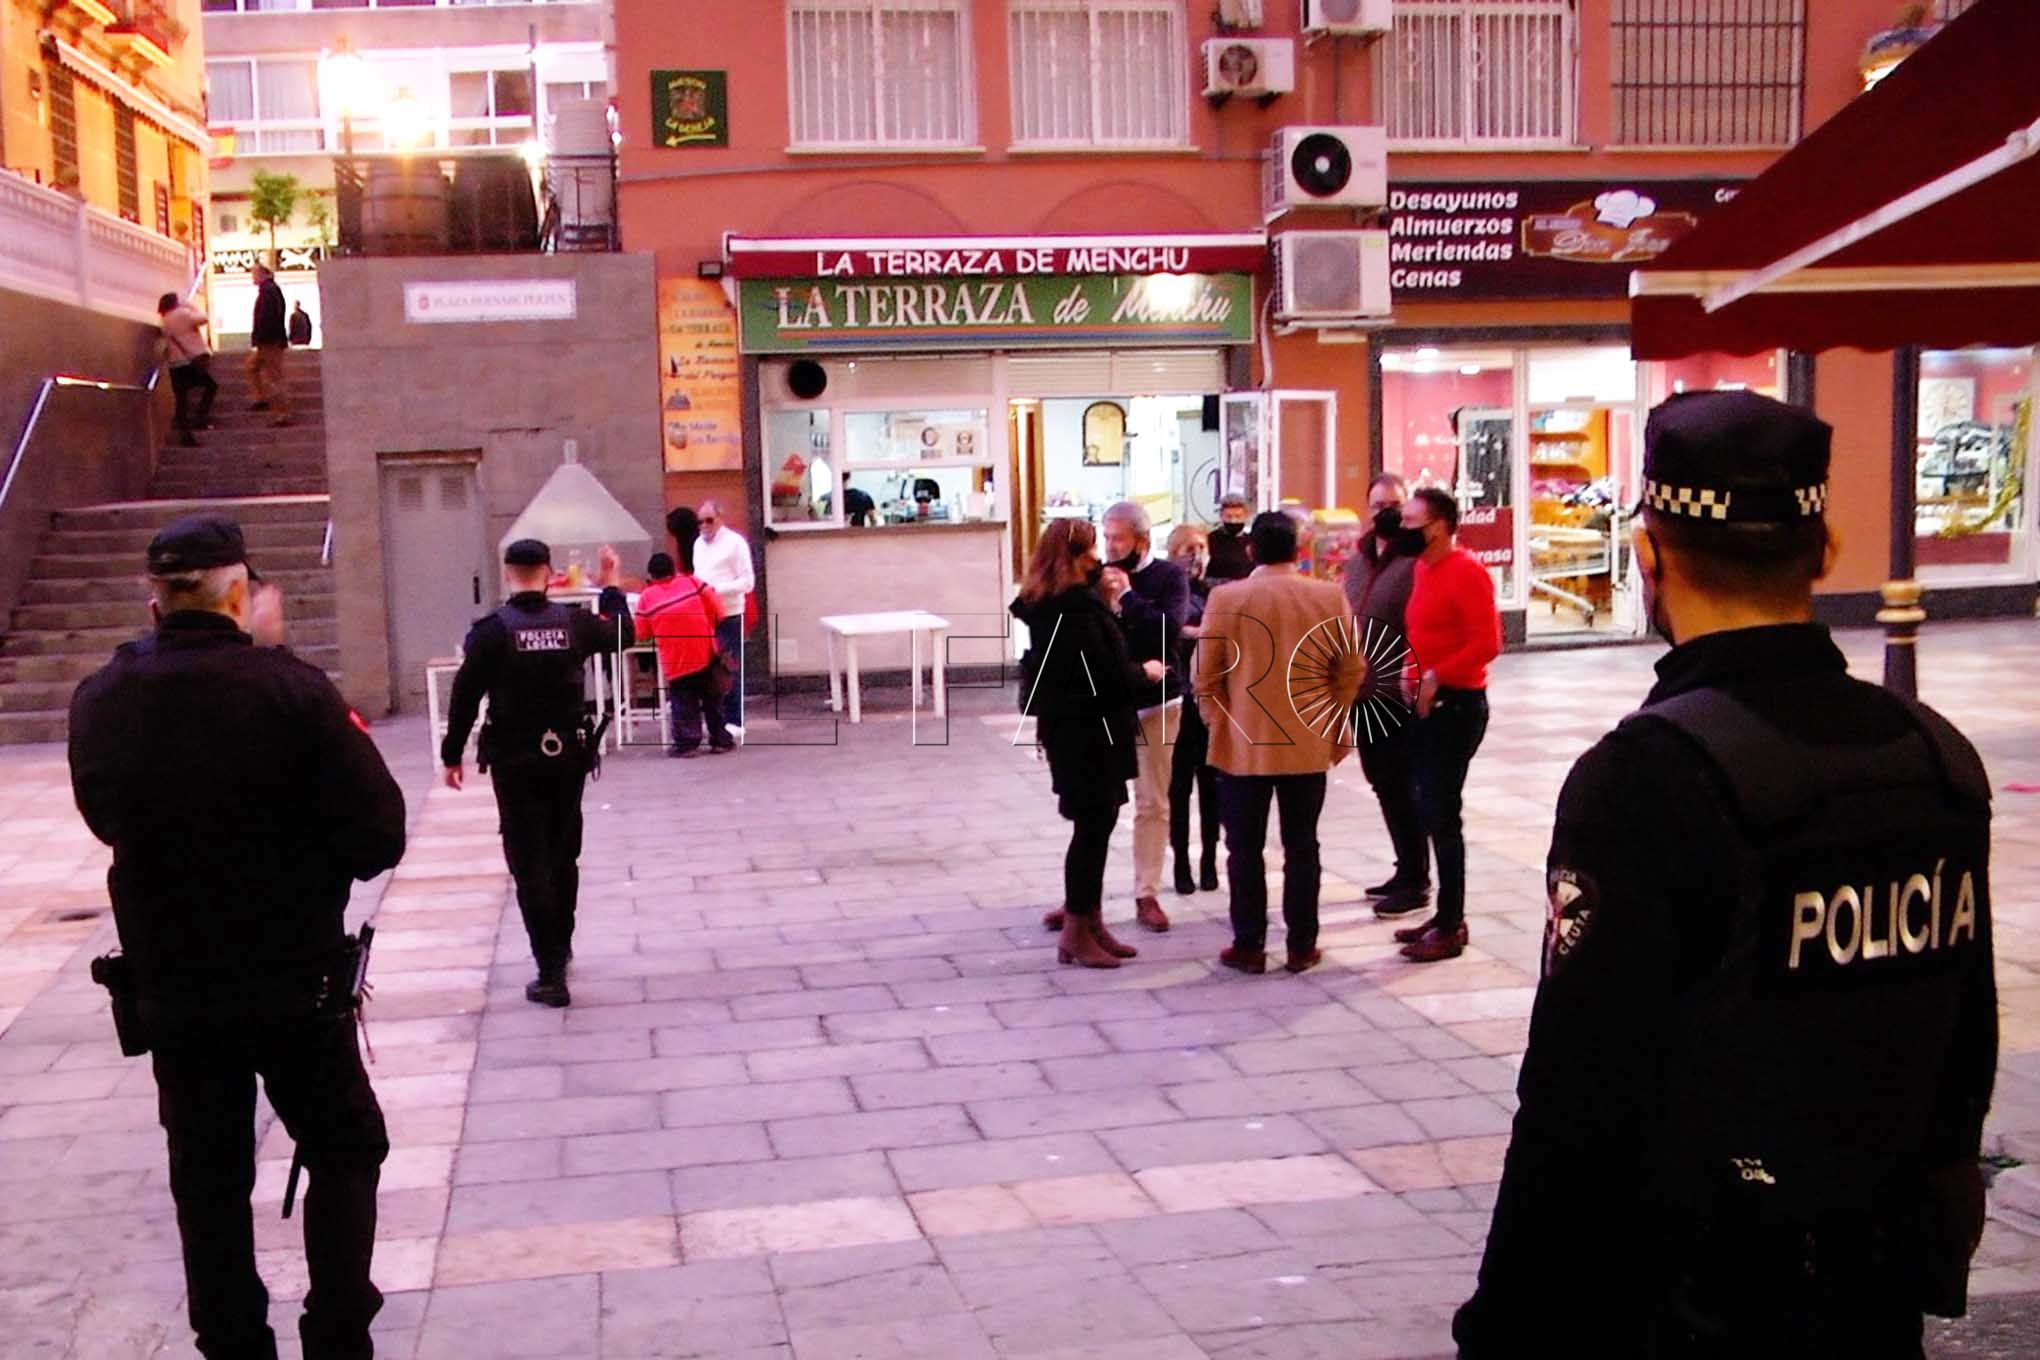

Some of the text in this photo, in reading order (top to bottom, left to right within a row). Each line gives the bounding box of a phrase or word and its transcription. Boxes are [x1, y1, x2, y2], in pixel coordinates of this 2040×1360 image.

[1390, 191, 1518, 213] Desayunos
[1390, 216, 1513, 236] Almuerzos
[816, 247, 1189, 276] LA TERRAZA DE MENCHU
[1391, 240, 1513, 261] Meriendas
[1391, 268, 1462, 288] Cenas
[776, 285, 832, 329] LA
[835, 282, 1035, 328] TERRAZA
[1053, 284, 1091, 323] de
[526, 640, 561, 650] LOCAL
[1789, 858, 1976, 969] POLICÍA
[1558, 909, 1592, 955] CEUTA
